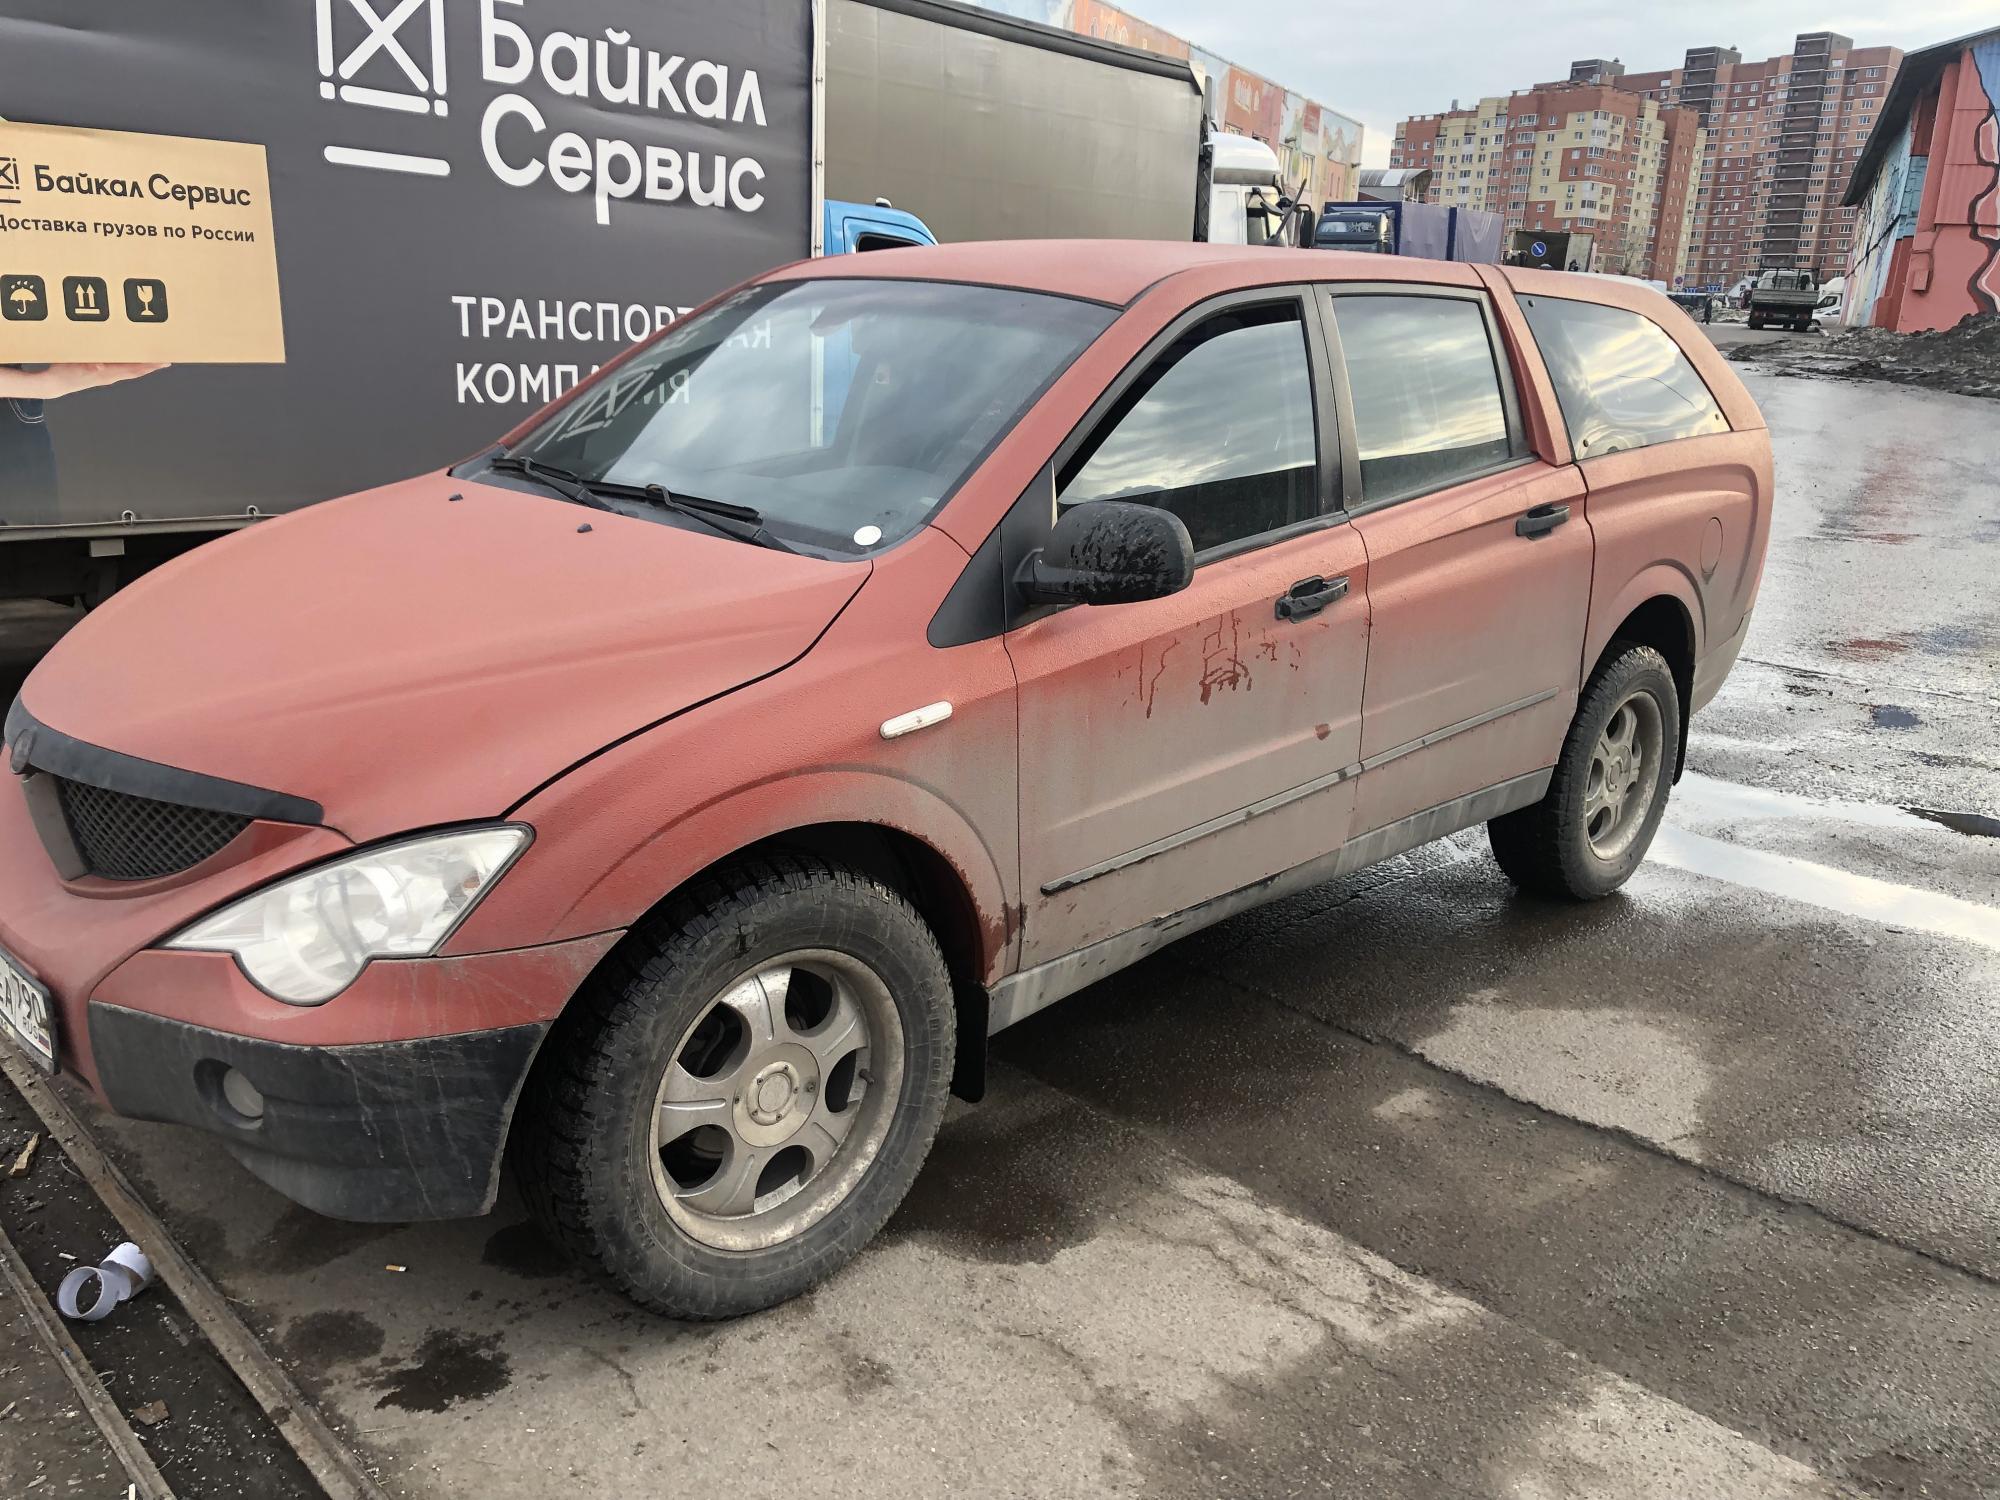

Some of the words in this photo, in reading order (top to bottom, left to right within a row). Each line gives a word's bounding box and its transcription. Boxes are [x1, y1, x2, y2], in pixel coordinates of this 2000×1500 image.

[480, 0, 767, 127] Байкал
[34, 164, 144, 198] Байкал
[148, 173, 251, 210] Сервис
[481, 93, 766, 225] Сервис
[93, 220, 158, 237] грузов
[163, 225, 186, 239] по
[192, 225, 255, 243] России
